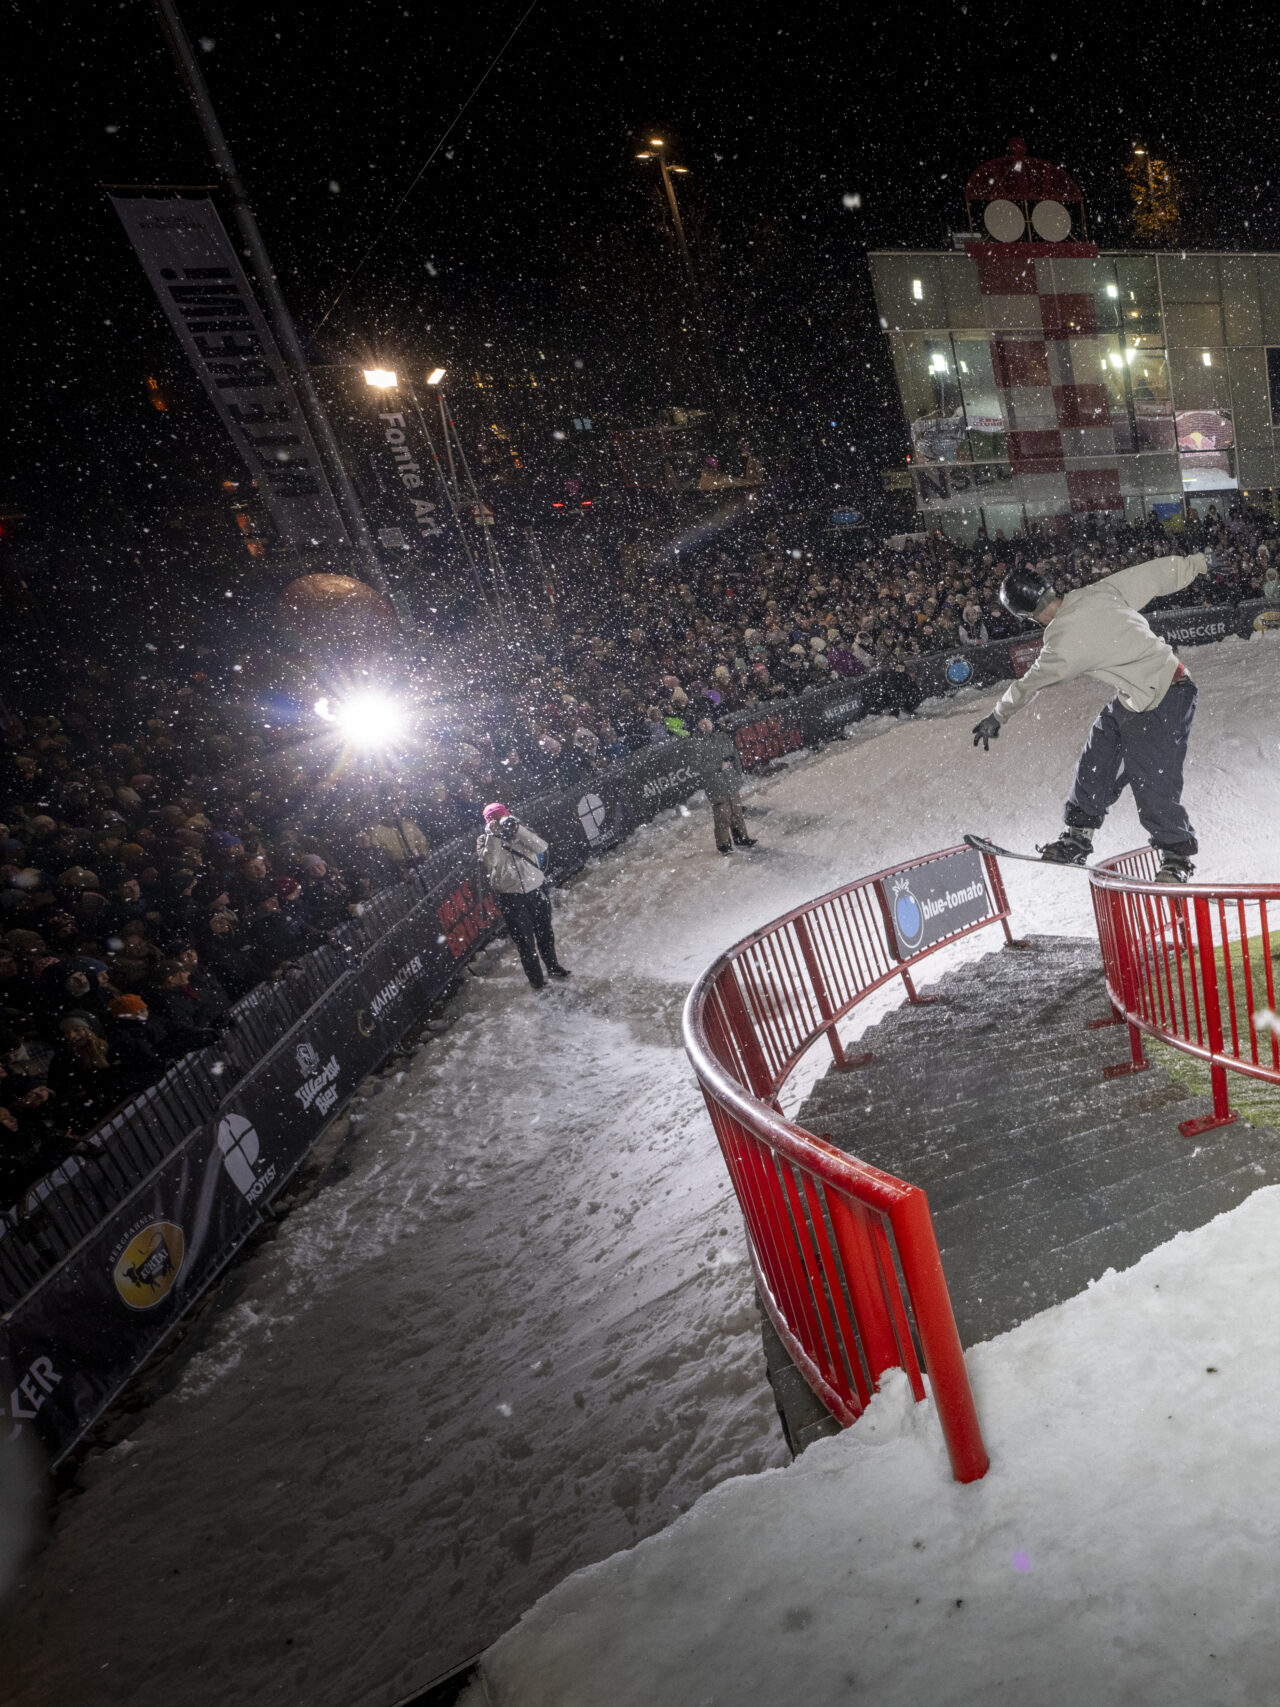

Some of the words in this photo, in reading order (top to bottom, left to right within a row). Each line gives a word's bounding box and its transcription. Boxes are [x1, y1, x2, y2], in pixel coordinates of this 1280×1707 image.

[410, 498, 443, 538] Art
[1167, 622, 1226, 641] NIDECKER
[824, 699, 860, 720] WEBER
[643, 765, 700, 799] NIDECK
[921, 881, 984, 921] blue-tomato
[245, 1163, 277, 1206] PROTEST
